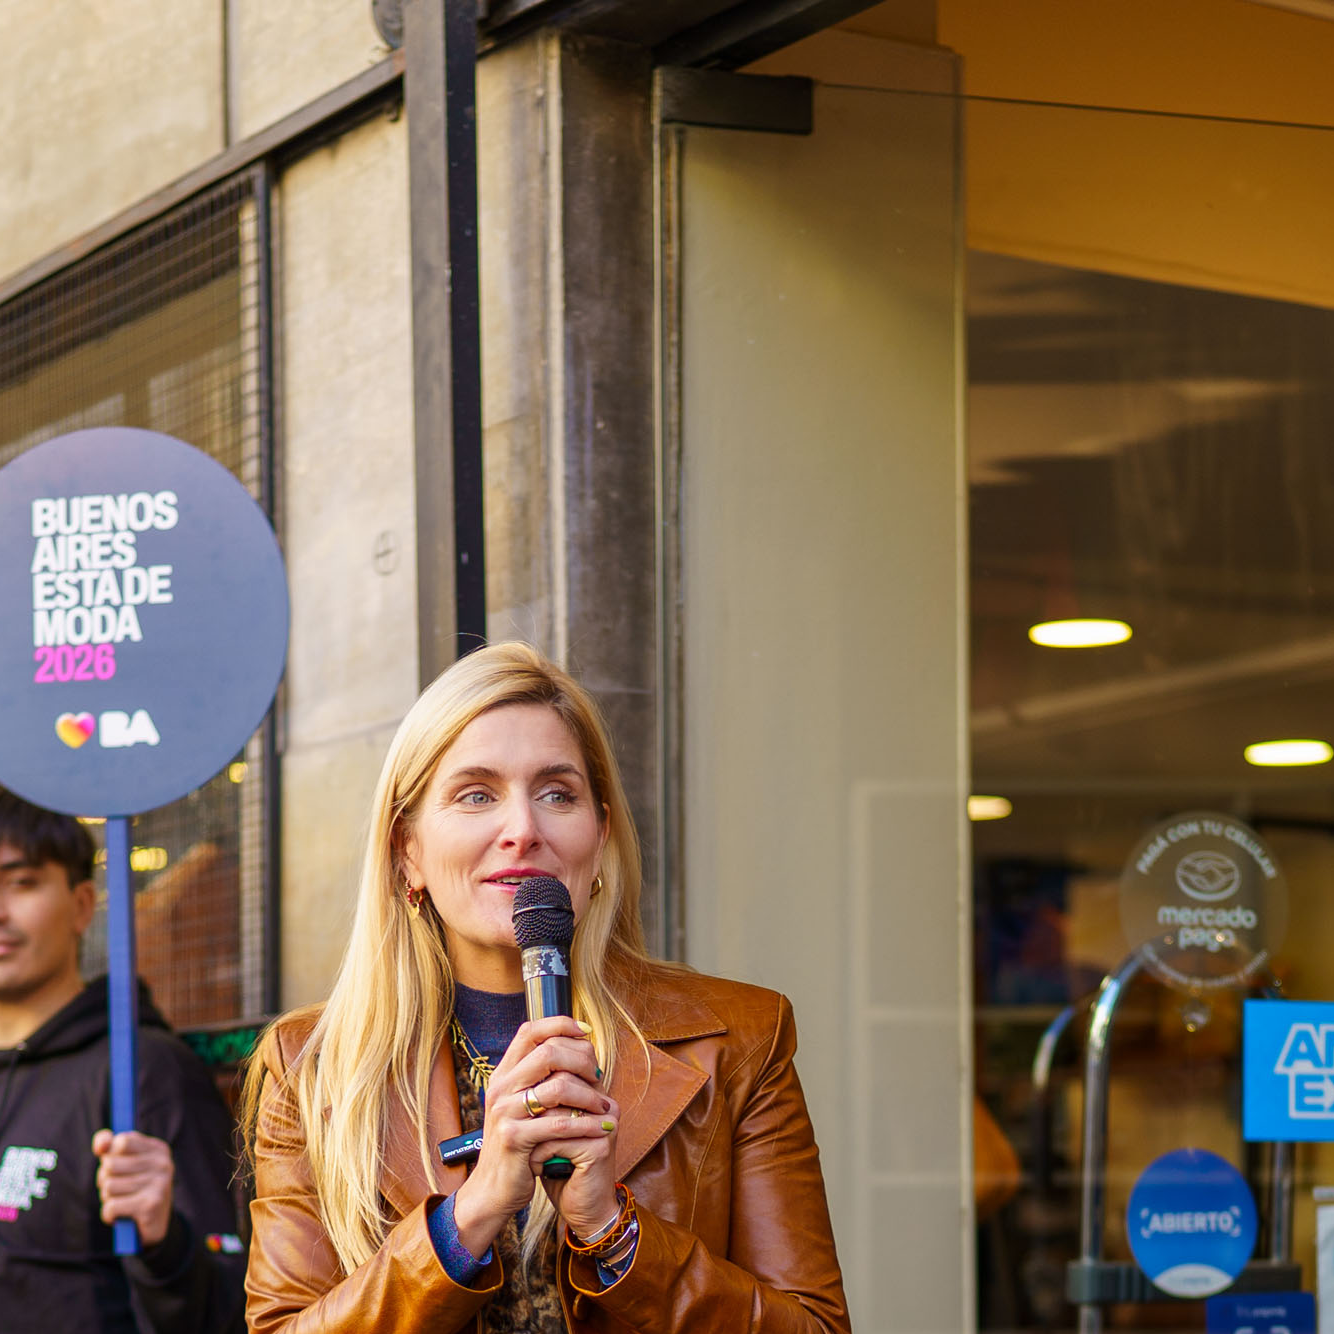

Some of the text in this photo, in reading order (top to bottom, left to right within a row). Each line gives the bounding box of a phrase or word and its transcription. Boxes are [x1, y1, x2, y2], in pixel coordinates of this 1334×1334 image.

[32, 490, 179, 537] BUENOS
[30, 531, 137, 573] AIRES
[122, 565, 173, 605] DE
[33, 605, 143, 647] MODA
[33, 643, 116, 683] 2026
[99, 709, 160, 748] BA
[1167, 821, 1200, 842] CON
[1202, 820, 1223, 836] TU
[1157, 905, 1257, 930] mercado
[1178, 926, 1235, 953] pago
[1148, 1210, 1234, 1235] ABIERTO
